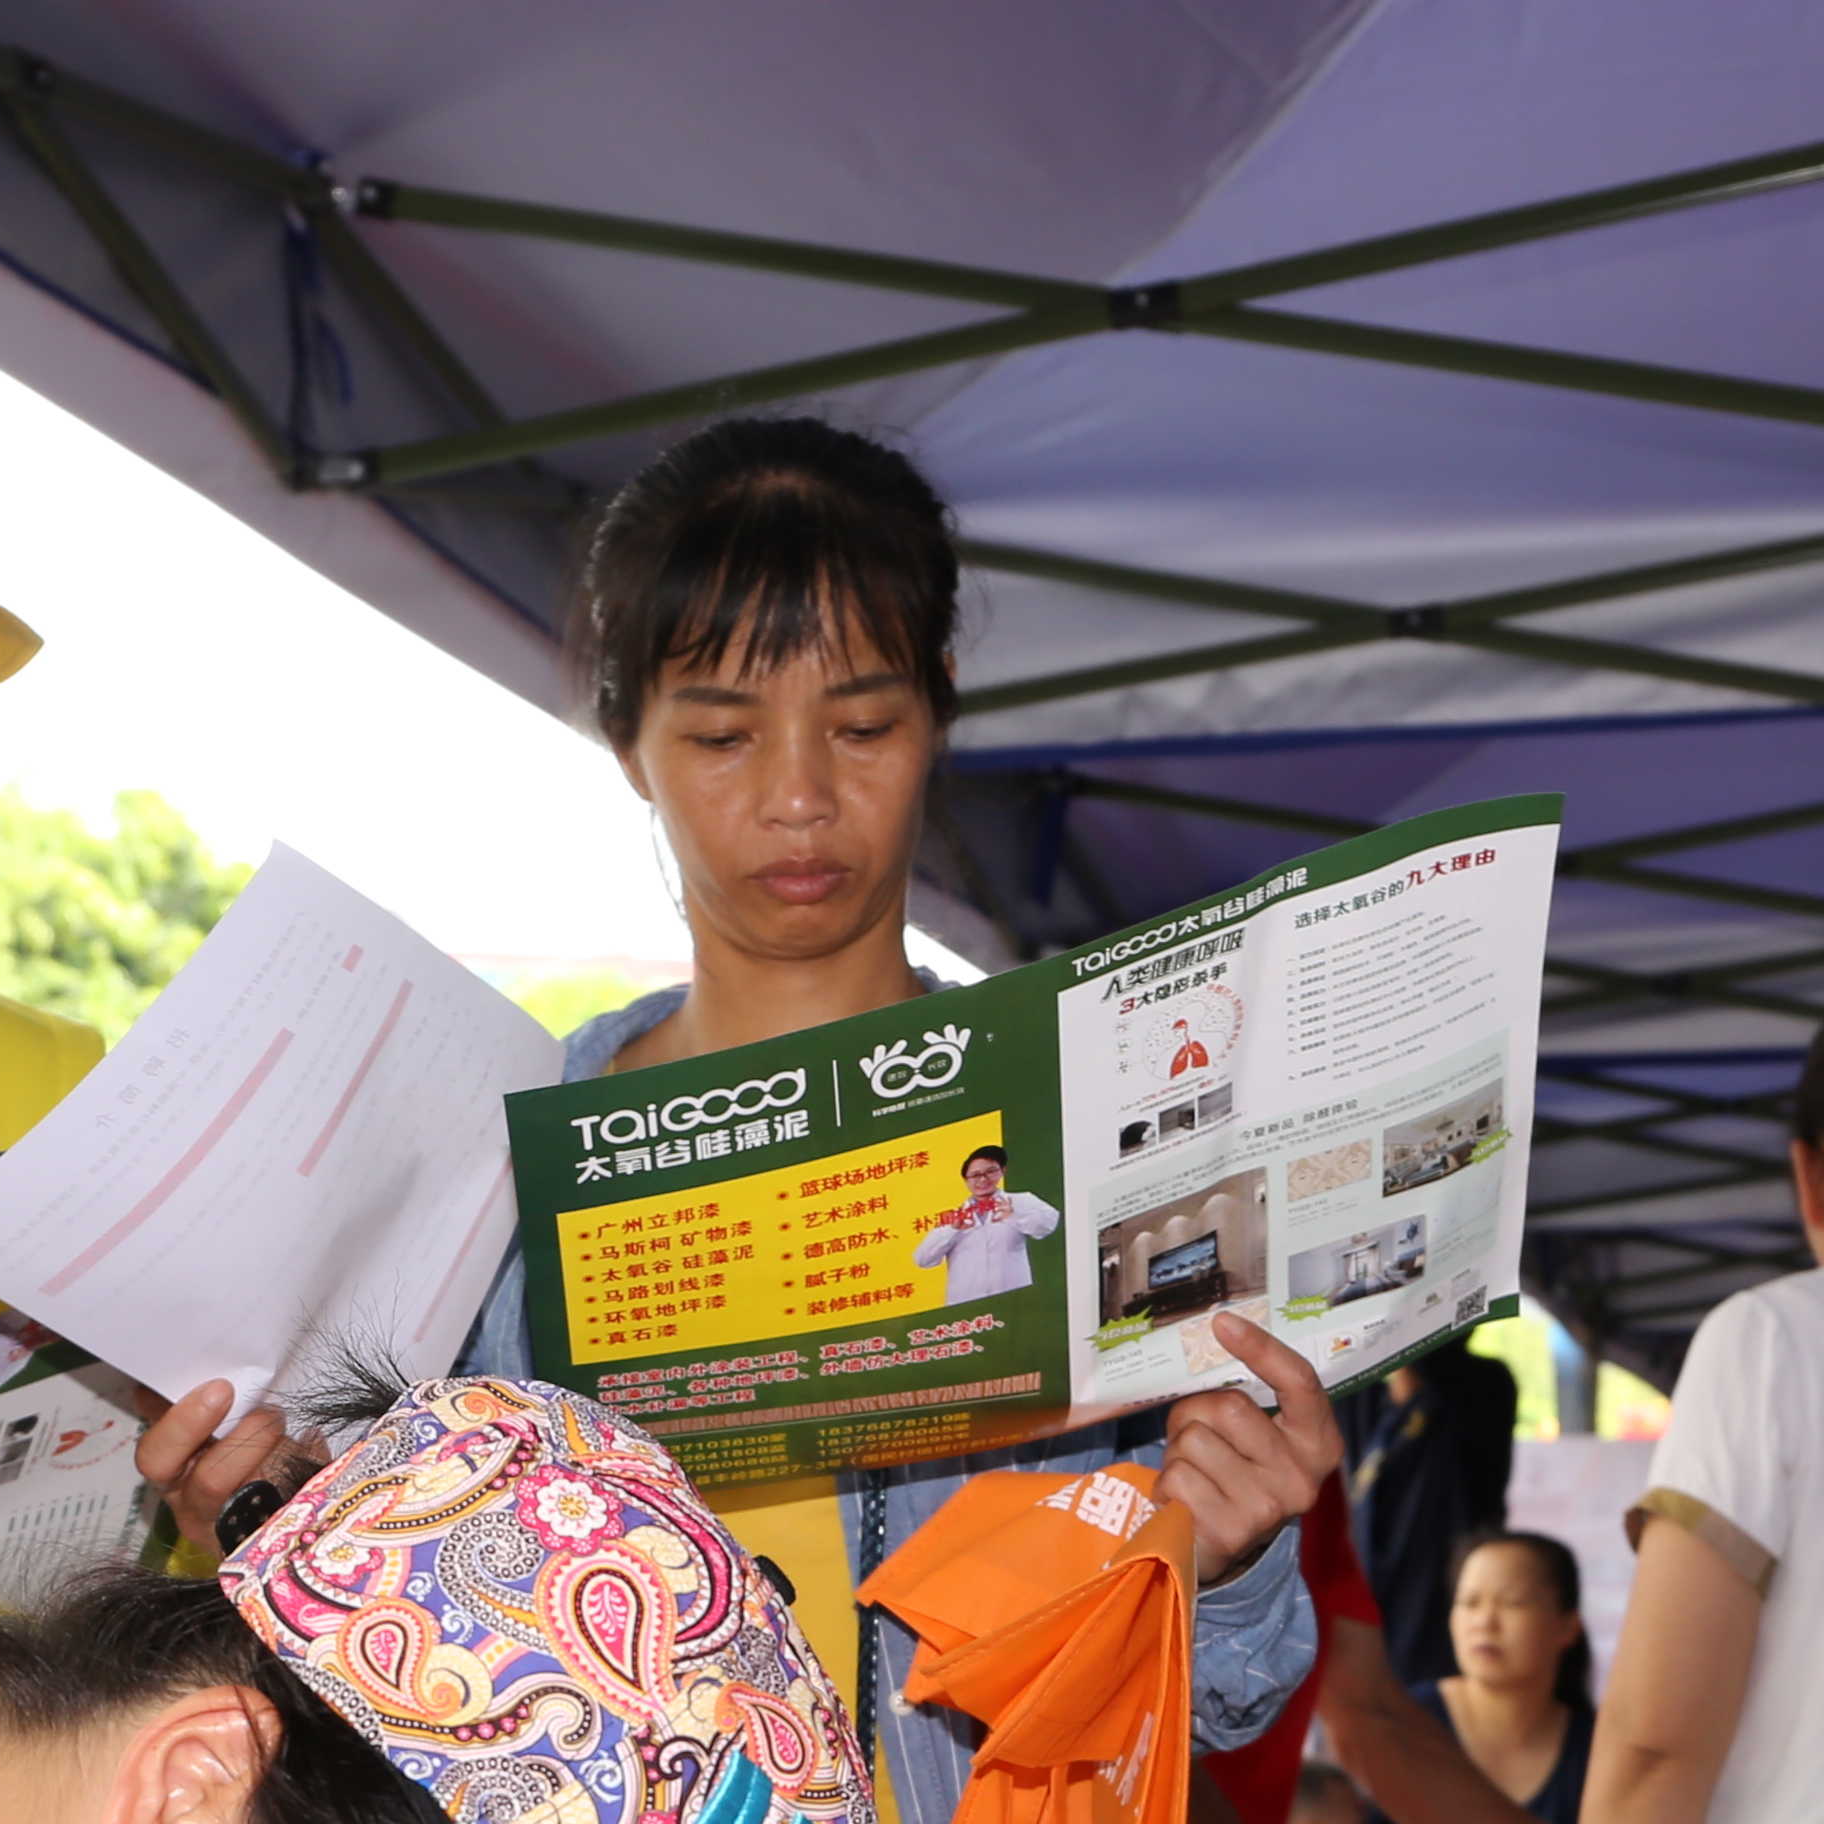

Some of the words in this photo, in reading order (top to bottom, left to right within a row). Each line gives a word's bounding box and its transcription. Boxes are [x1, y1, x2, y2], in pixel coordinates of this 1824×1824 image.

[575, 1109, 810, 1184] 太氧谷硅藻泥
[798, 1150, 931, 1200] 篮球场地坪漆
[596, 1202, 721, 1240] 广州立邦漆
[800, 1194, 889, 1229] 艺术涂料
[680, 1220, 753, 1249] 矿物漆
[600, 1258, 672, 1283] 太氧谷
[803, 1262, 872, 1288] 腻子粉
[603, 1273, 726, 1305] 马路划线漆
[806, 1283, 915, 1317] 装修辅料等
[604, 1294, 728, 1326] 环氧地坪漆
[607, 1323, 678, 1346] 真石漆
